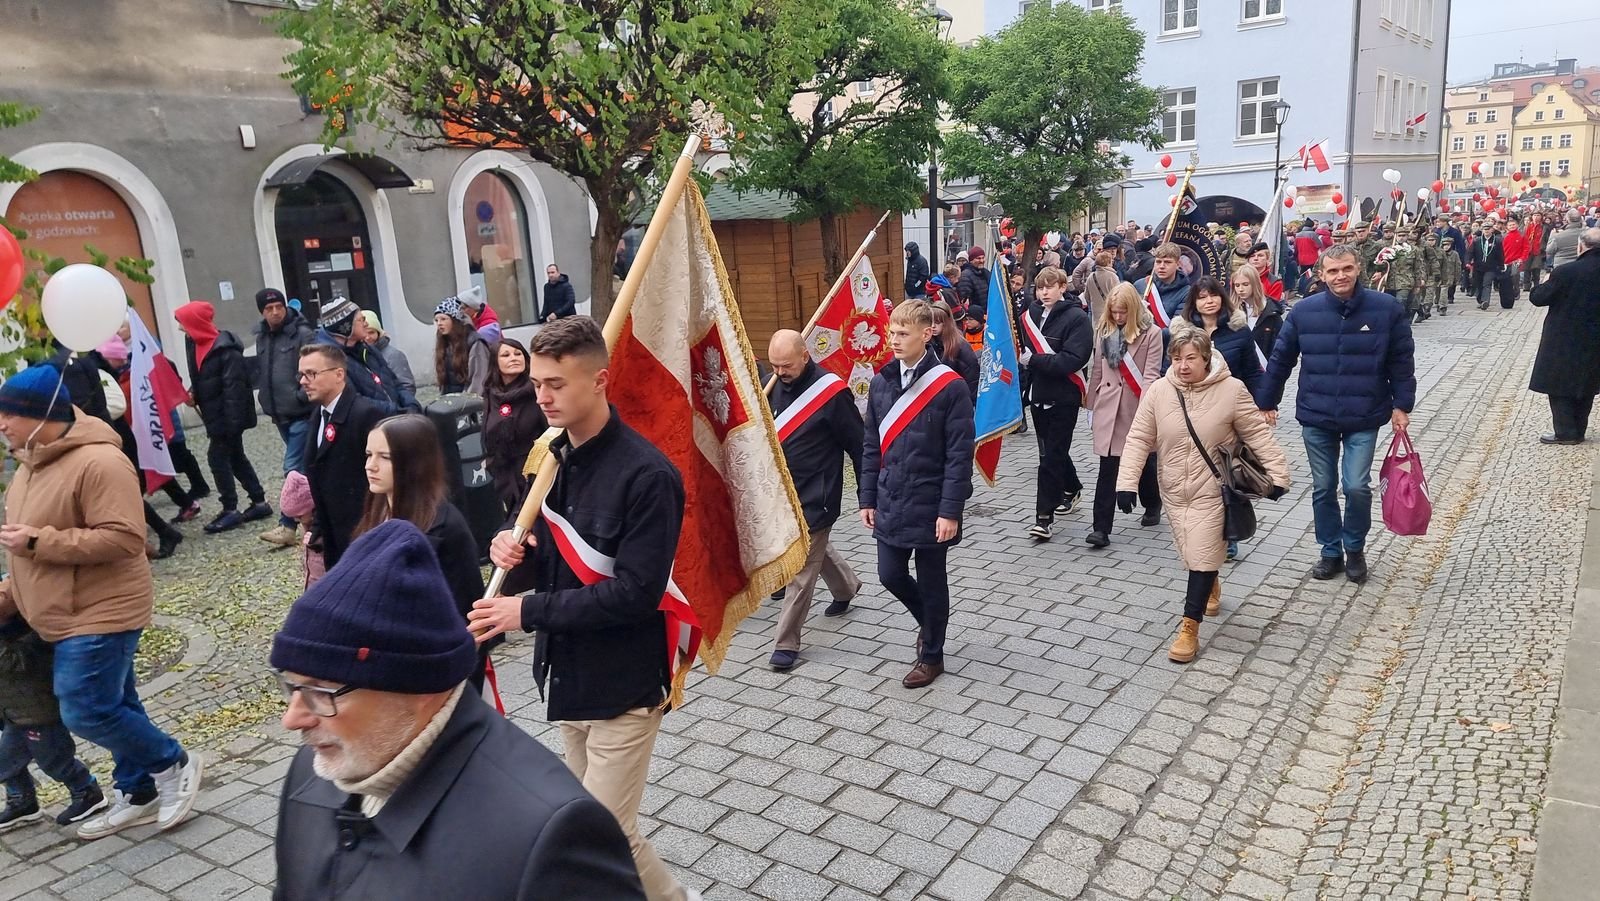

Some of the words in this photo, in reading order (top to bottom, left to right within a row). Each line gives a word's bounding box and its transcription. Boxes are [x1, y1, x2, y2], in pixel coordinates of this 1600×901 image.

[18, 211, 62, 225] Apteka
[64, 208, 115, 222] otwarta
[1175, 231, 1200, 245] EFANA
